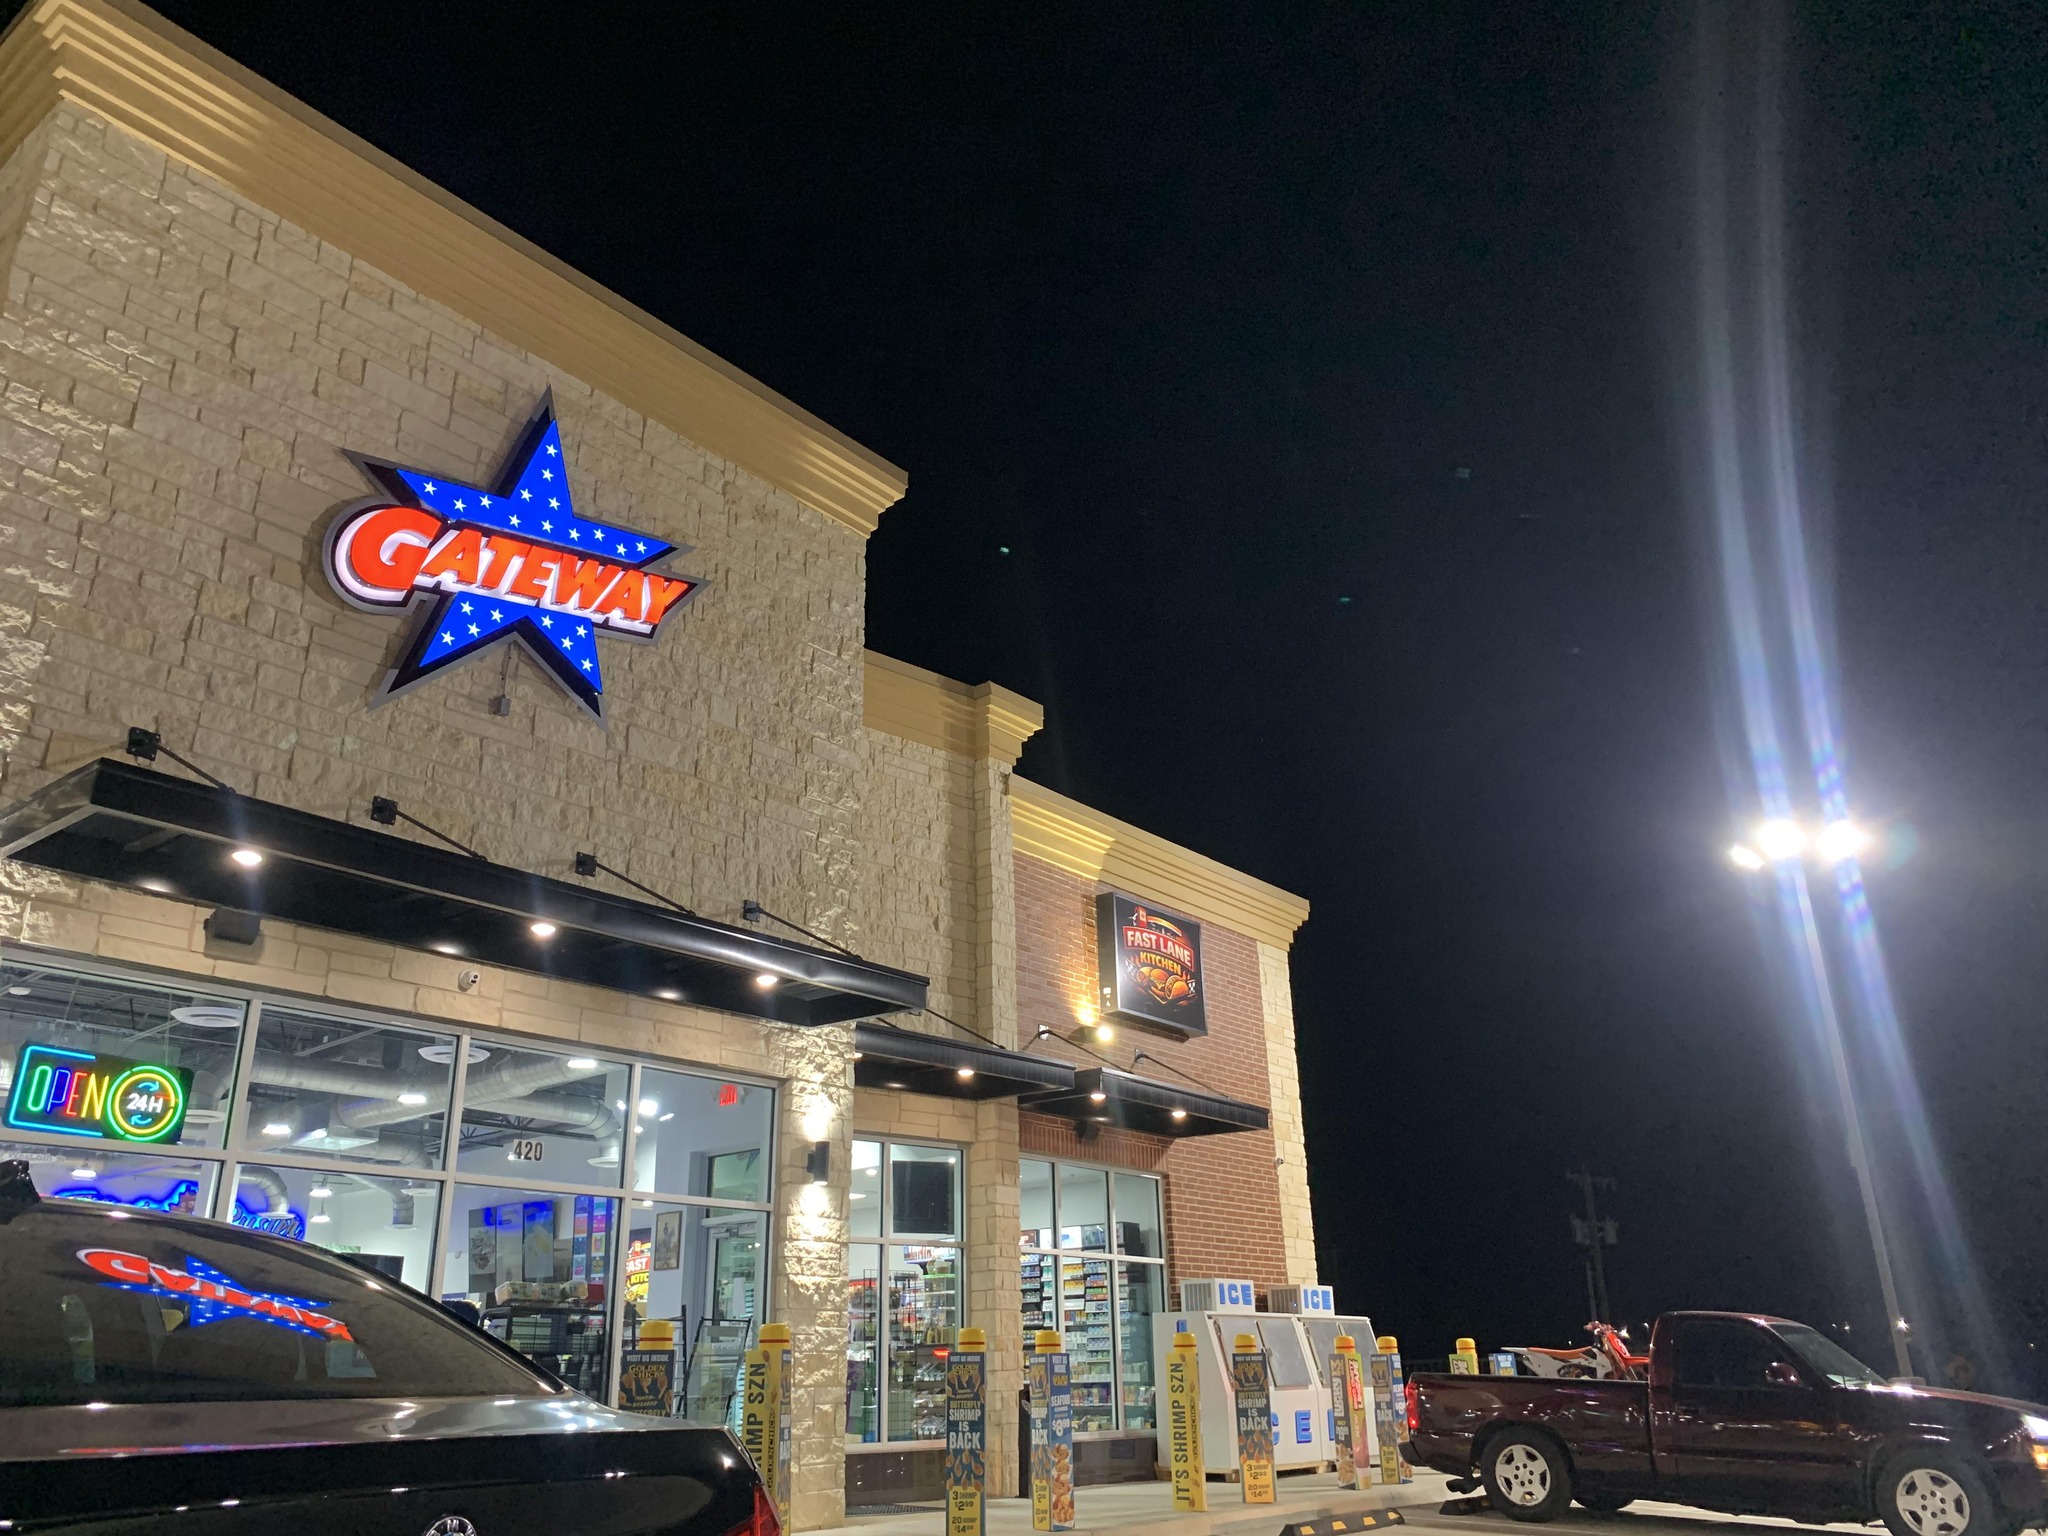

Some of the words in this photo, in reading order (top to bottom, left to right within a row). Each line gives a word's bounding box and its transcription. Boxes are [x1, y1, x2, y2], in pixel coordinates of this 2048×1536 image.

[347, 506, 690, 625] GATEWAY
[1127, 930, 1157, 950] FAST
[1160, 937, 1192, 967] LANE
[1139, 951, 1182, 974] KITCHEN
[27, 1065, 110, 1120] OPEN
[126, 1092, 164, 1114] 24H
[513, 1140, 544, 1162] 420
[630, 1273, 650, 1285] KITC
[1218, 1283, 1253, 1306] ICE
[1303, 1289, 1332, 1310] ICE
[630, 1364, 666, 1373] GOLDEN
[1169, 1362, 1185, 1394] SZN
[748, 1363, 766, 1404] SZN
[948, 1408, 982, 1421] SHRIMP
[1238, 1399, 1267, 1409] SHRIMP
[1247, 1408, 1258, 1417] IS
[958, 1421, 970, 1432] IS
[1171, 1400, 1189, 1463] SHRIMP
[1239, 1416, 1269, 1431] BACK
[949, 1431, 981, 1450] BACK
[1246, 1464, 1252, 1472] 3
[1175, 1468, 1190, 1501] IT'S
[952, 1491, 959, 1500] 3
[951, 1516, 962, 1524] 20
